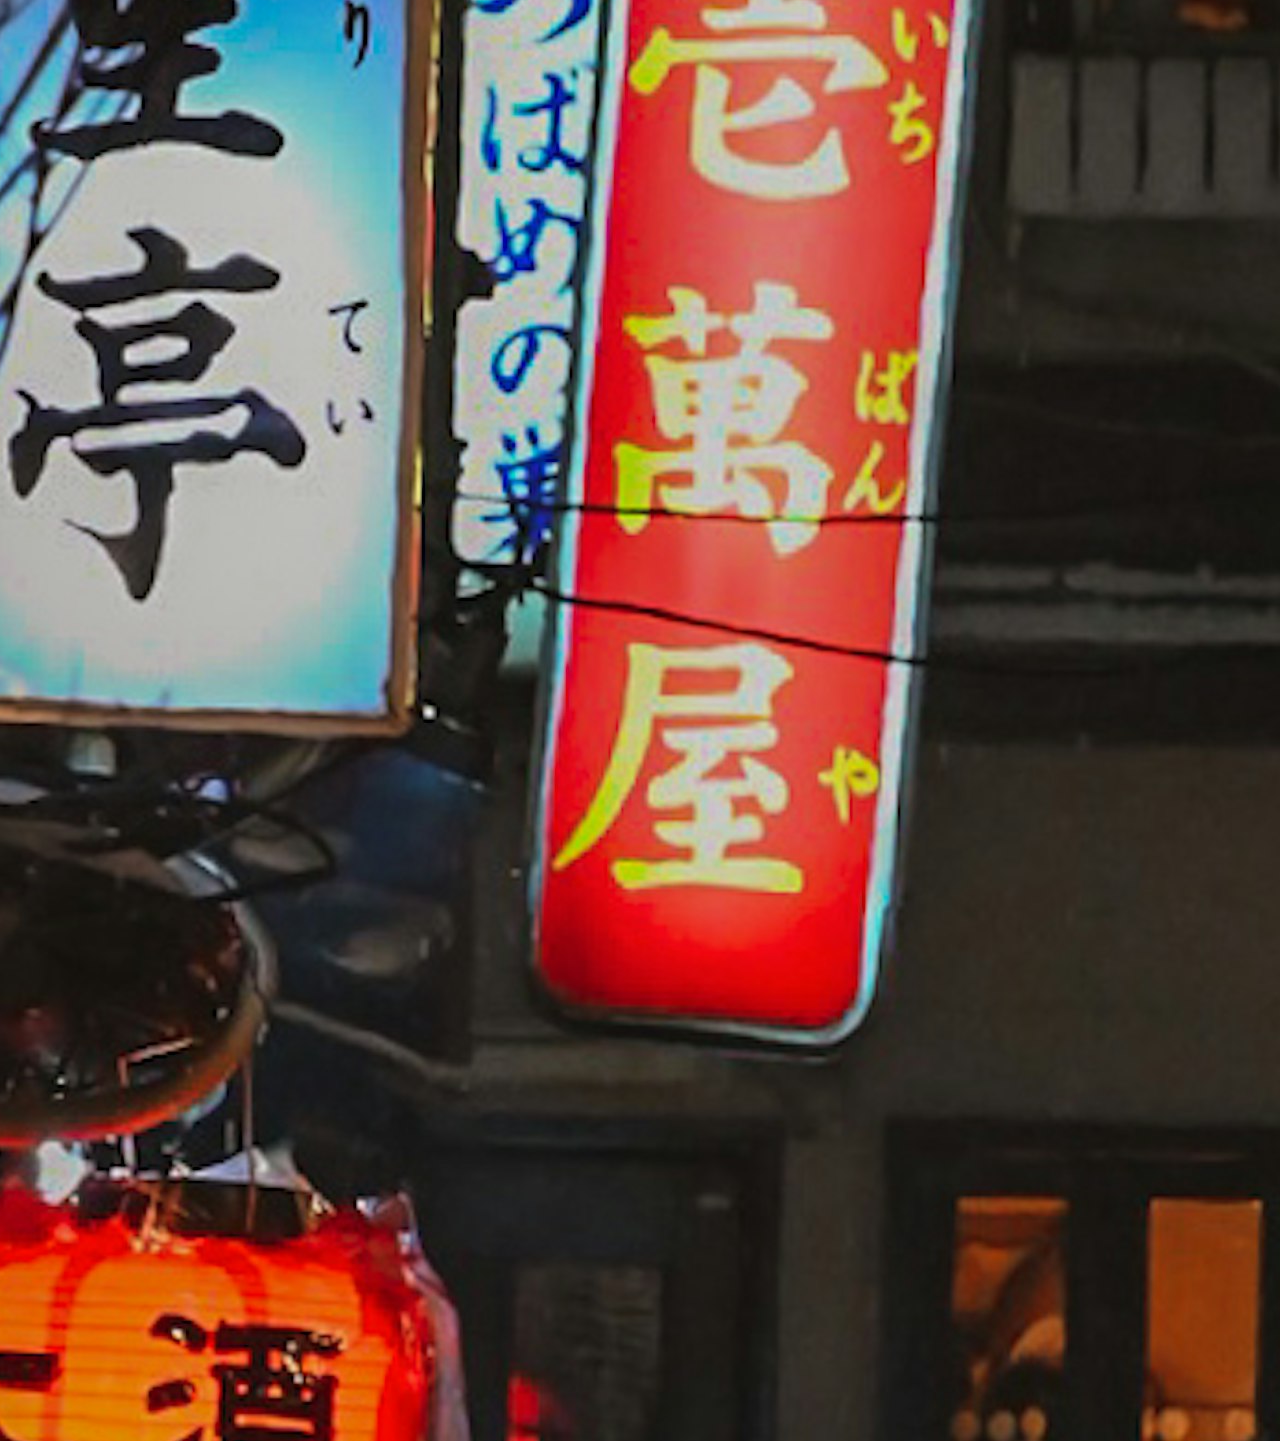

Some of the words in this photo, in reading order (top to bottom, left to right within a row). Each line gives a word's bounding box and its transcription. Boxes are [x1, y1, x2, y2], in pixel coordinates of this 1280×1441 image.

[344, 0, 370, 68] り
[888, 7, 950, 163] いち
[328, 300, 374, 436] てい
[844, 351, 920, 514] ばん
[817, 745, 880, 824] や
